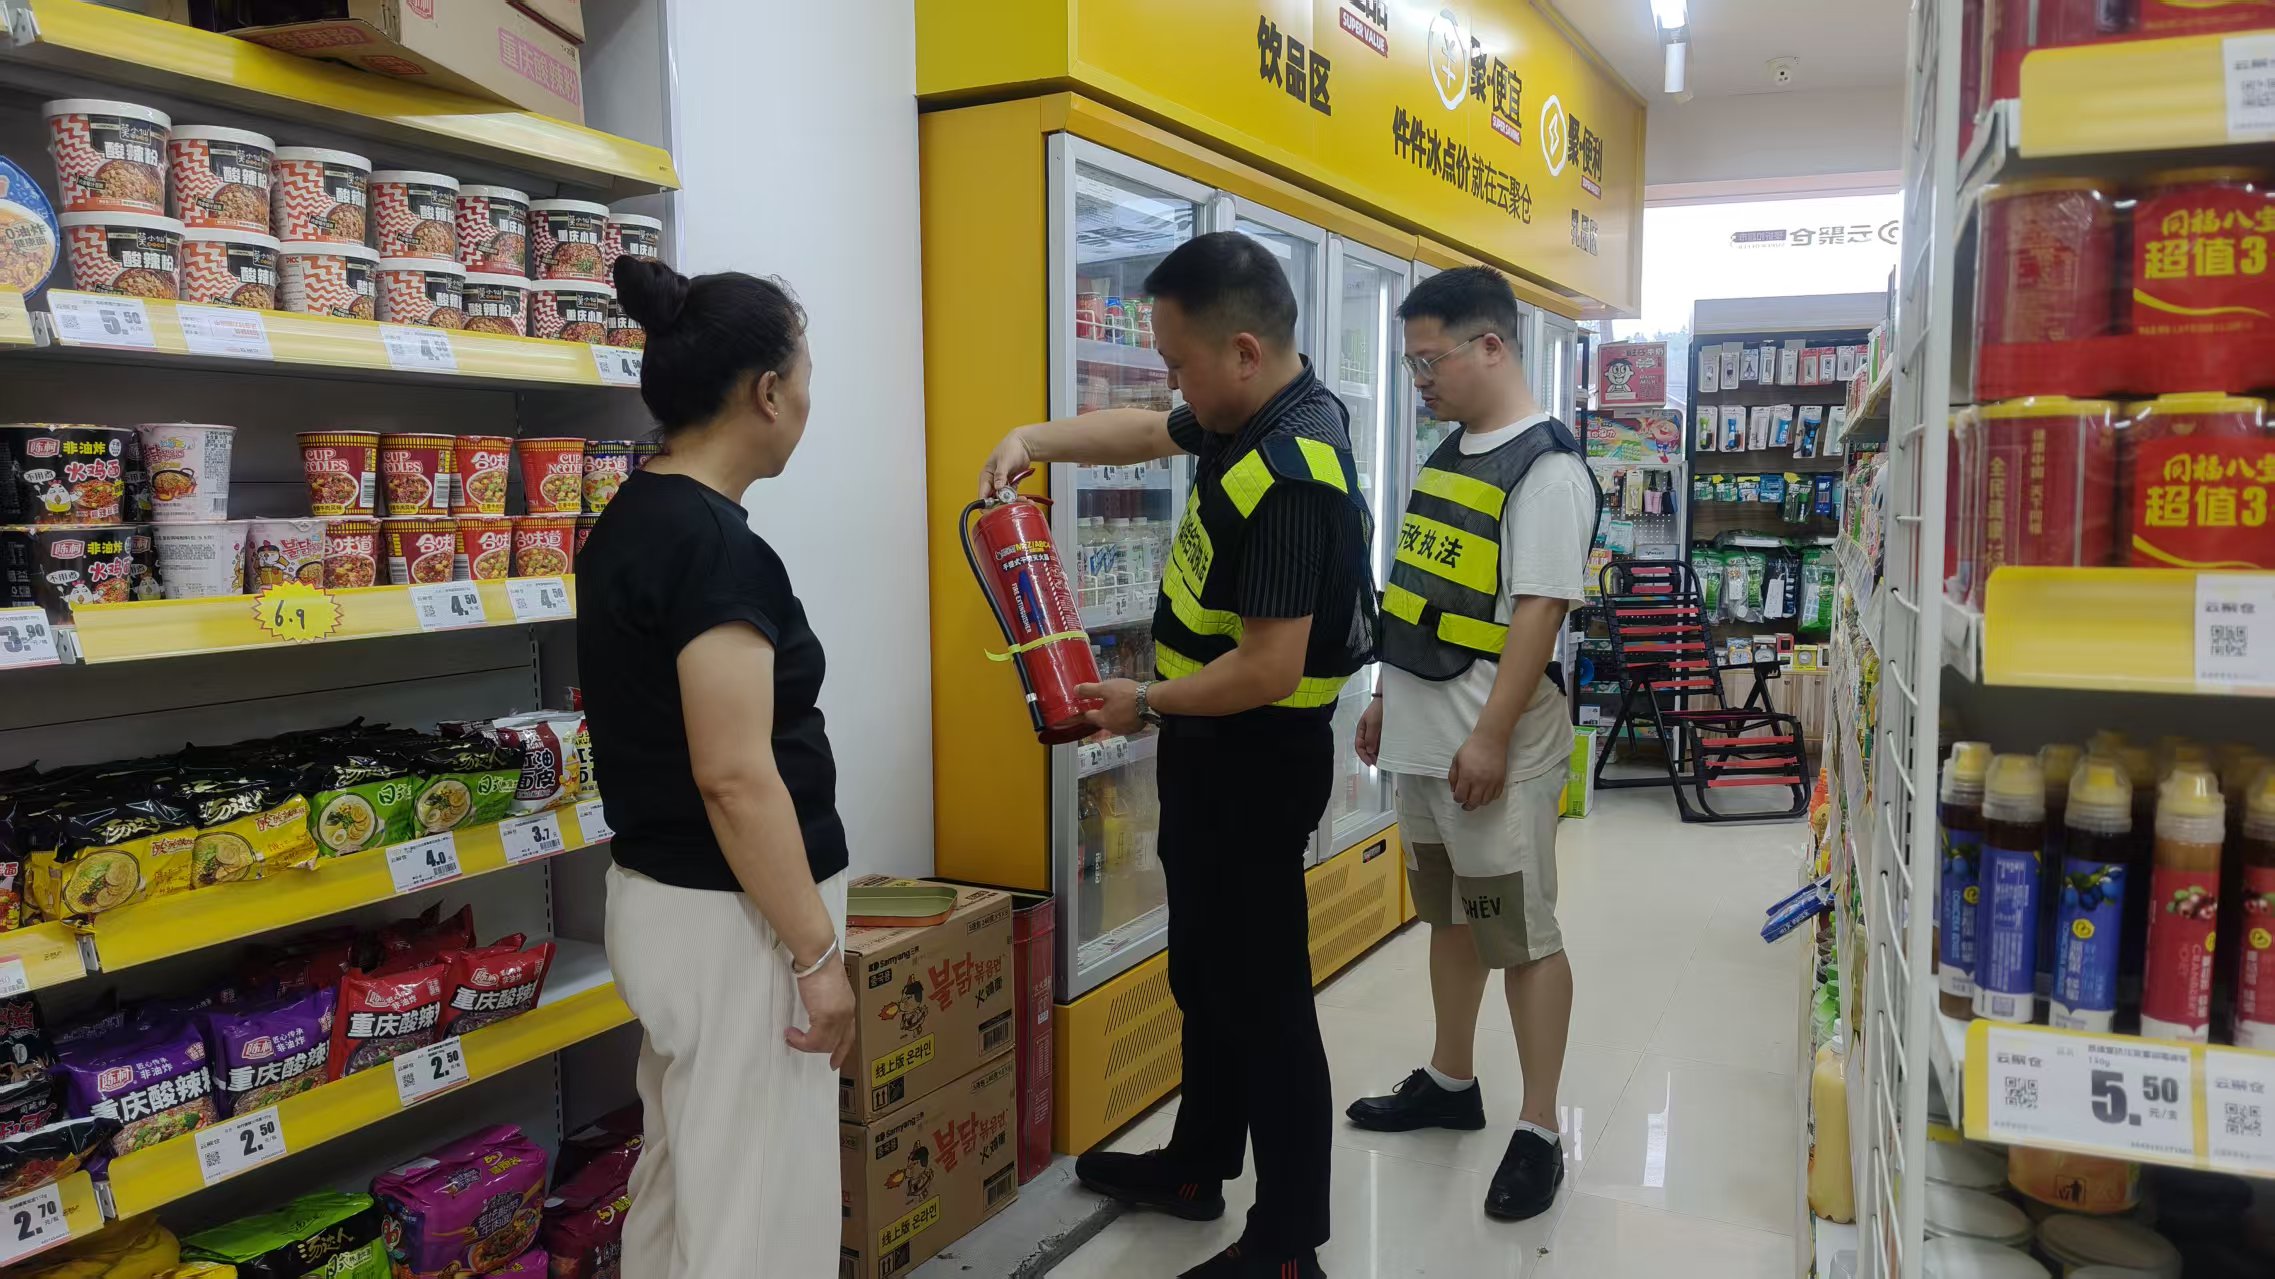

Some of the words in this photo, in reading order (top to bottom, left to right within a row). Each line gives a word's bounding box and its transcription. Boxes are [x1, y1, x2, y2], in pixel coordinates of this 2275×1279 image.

[1342, 11, 1364, 40] SUPER
[1364, 27, 1387, 54] VALUE
[1257, 14, 1332, 117] 饮品区
[1491, 115, 1507, 134] SUPER
[104, 140, 158, 167] 酸辣粉
[1392, 105, 1532, 225] 件件冰点价就在云聚仓
[222, 165, 268, 189] 酸辣粉
[557, 229, 598, 244] 重庆小面
[121, 250, 174, 272] 酸辣粉
[468, 301, 512, 318] 酸辣粉
[566, 308, 603, 323] 重庆小面
[99, 309, 141, 336] 5.50
[62, 440, 106, 455] 非油炸
[305, 448, 337, 461] CUP
[383, 450, 412, 463] CUP
[559, 453, 582, 464] CUP
[64, 458, 121, 483] 火鸡面
[87, 540, 124, 555] 非油炸
[515, 530, 562, 548] 合味道
[50, 571, 79, 583] 不用煮
[451, 593, 478, 616] 4.50
[540, 588, 564, 609] 4.50
[274, 599, 306, 630] 6.9
[1016, 595, 1033, 634] EXTINGUISHER
[0, 624, 46, 653] 3.90
[531, 825, 551, 844] 3.7
[426, 848, 447, 868] 4.0
[879, 949, 911, 968] Samyang
[275, 1036, 306, 1053] 非油炸
[139, 1062, 174, 1080] 非油炸
[228, 1042, 330, 1092] 重庆酸辣
[431, 1049, 460, 1080] 2.50
[875, 1053, 905, 1078] 线上版
[906, 1042, 932, 1066] 온라인
[2091, 1069, 2180, 1127] 5.50
[240, 1120, 276, 1157] 2.50
[885, 1115, 917, 1139] Samyang
[13, 1200, 57, 1242] 2.70
[881, 1220, 910, 1248] 线上版
[912, 1203, 937, 1231] 온라인
